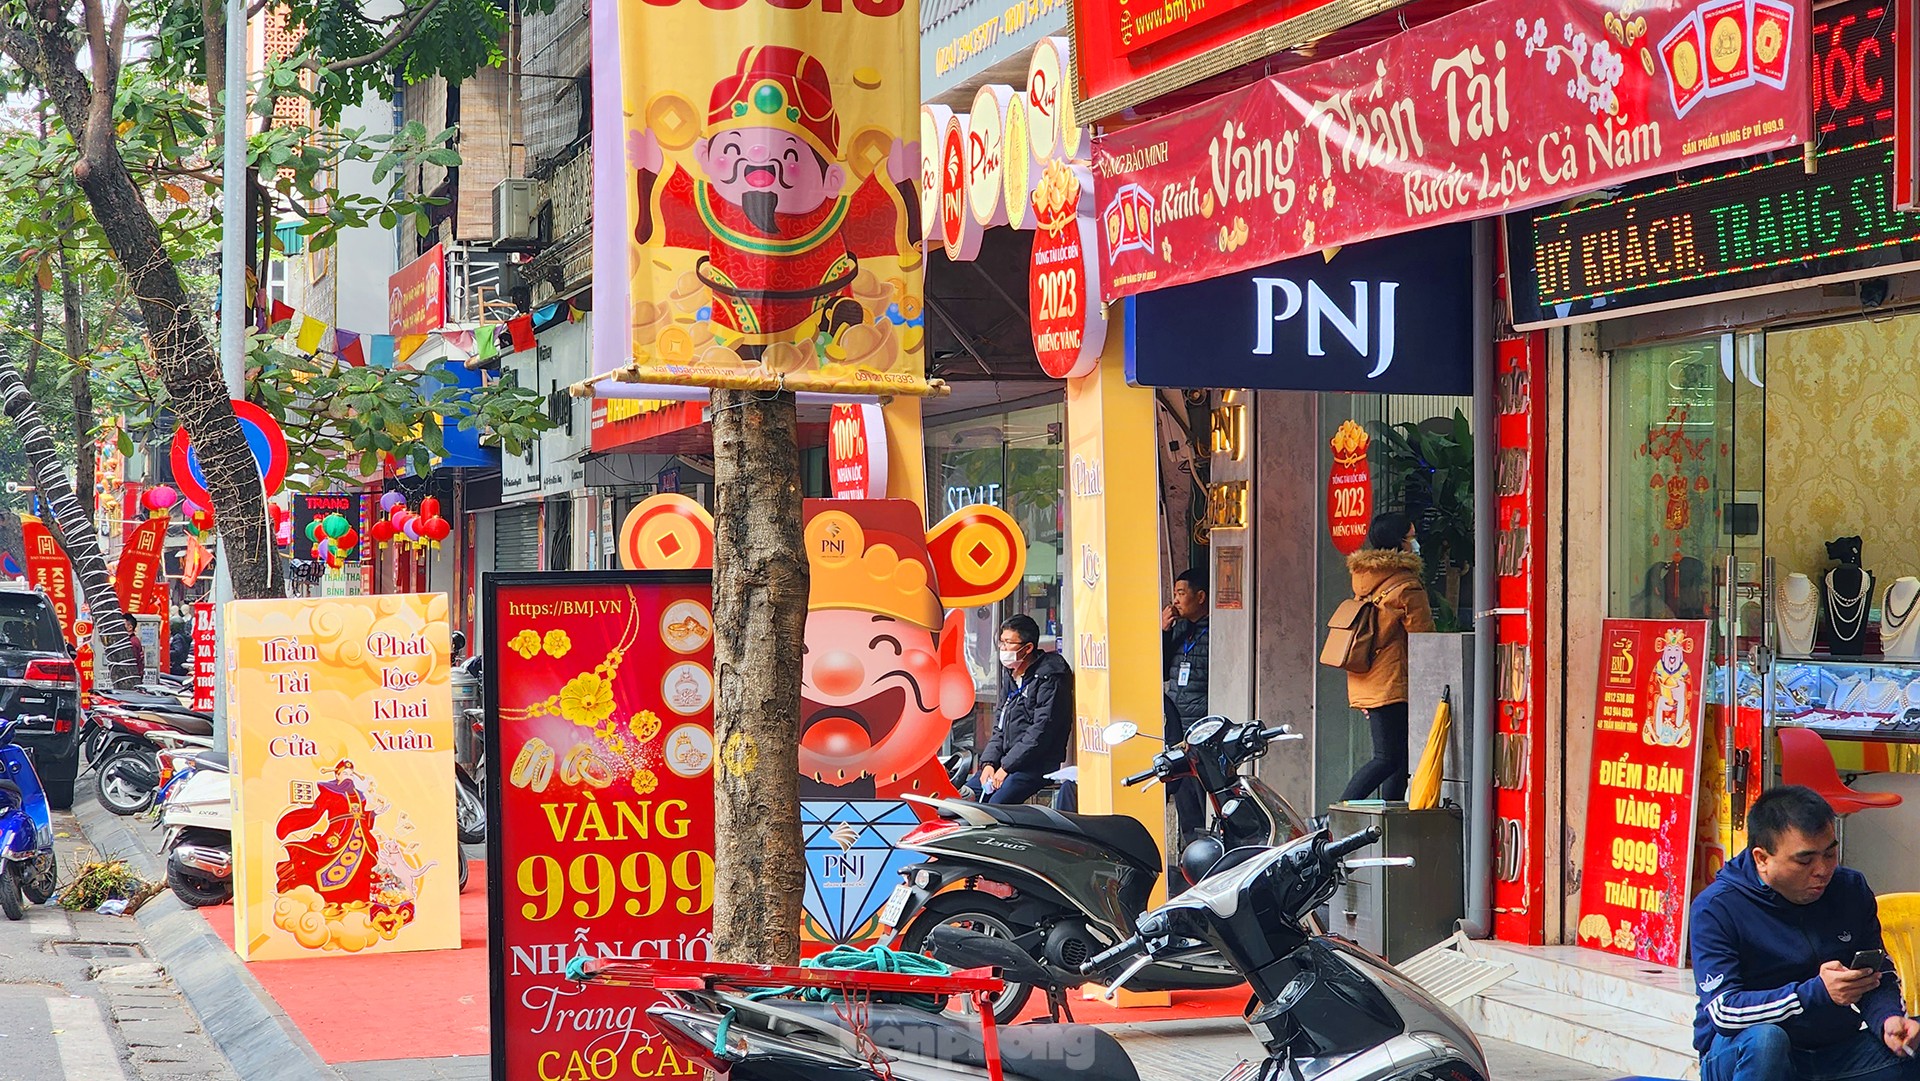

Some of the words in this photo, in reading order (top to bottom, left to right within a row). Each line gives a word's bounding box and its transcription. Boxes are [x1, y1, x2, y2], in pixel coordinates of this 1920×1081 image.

[1305, 58, 1424, 180] Thần
[1431, 40, 1509, 147] Tài
[1719, 130, 1741, 148] VÀNG
[1741, 127, 1752, 142] ÉP
[1762, 120, 1784, 136] 999.9
[1146, 141, 1169, 168] MINH
[1208, 120, 1299, 215] Vàng
[1403, 162, 1473, 217] Rước
[1477, 146, 1531, 209] Lộc
[1538, 125, 1578, 185] Cả
[1585, 113, 1662, 174] Năm
[945, 188, 961, 225] PNJ
[1161, 176, 1199, 224] Rinh
[1709, 184, 1842, 263] TRANG
[1038, 267, 1077, 321] 2023
[1037, 326, 1060, 353] MIẾNG
[1060, 326, 1081, 349] VÀNG
[1252, 277, 1400, 379] PNJ
[832, 417, 864, 460] 100%
[837, 464, 852, 486] NHẬN
[852, 462, 863, 484] LỘC
[1071, 454, 1102, 498] Phát
[305, 498, 350, 510] TRANG
[1334, 486, 1365, 518] 2023
[1332, 521, 1350, 537] MIẾNG
[1350, 523, 1367, 536] VÀNG
[821, 540, 845, 555] PNJ
[51, 567, 66, 598] KIM
[1080, 543, 1101, 590] Lộc
[509, 599, 623, 619] https://BMJ.VN
[258, 636, 319, 663] Thần
[367, 631, 430, 657] Phát
[1079, 632, 1108, 670] Khai
[271, 670, 311, 694] Tài
[381, 666, 419, 691] Lộc
[275, 704, 310, 725] Gõ
[373, 698, 429, 720] Khai
[269, 733, 318, 757] Cửa
[371, 728, 434, 752] Xuân
[1600, 752, 1641, 787] ĐIỂM
[1647, 762, 1684, 794] BÁN
[540, 790, 692, 842] VÀNG
[1615, 795, 1661, 829] VÀNG
[976, 837, 1028, 852] Janus
[1612, 837, 1659, 876] 9999
[823, 854, 865, 882] PNJ
[516, 850, 715, 921] 9999
[1605, 877, 1638, 911] THẦN
[1639, 885, 1660, 912] TÀI
[521, 985, 637, 1065] Trang
[537, 1048, 618, 1081] CAO
